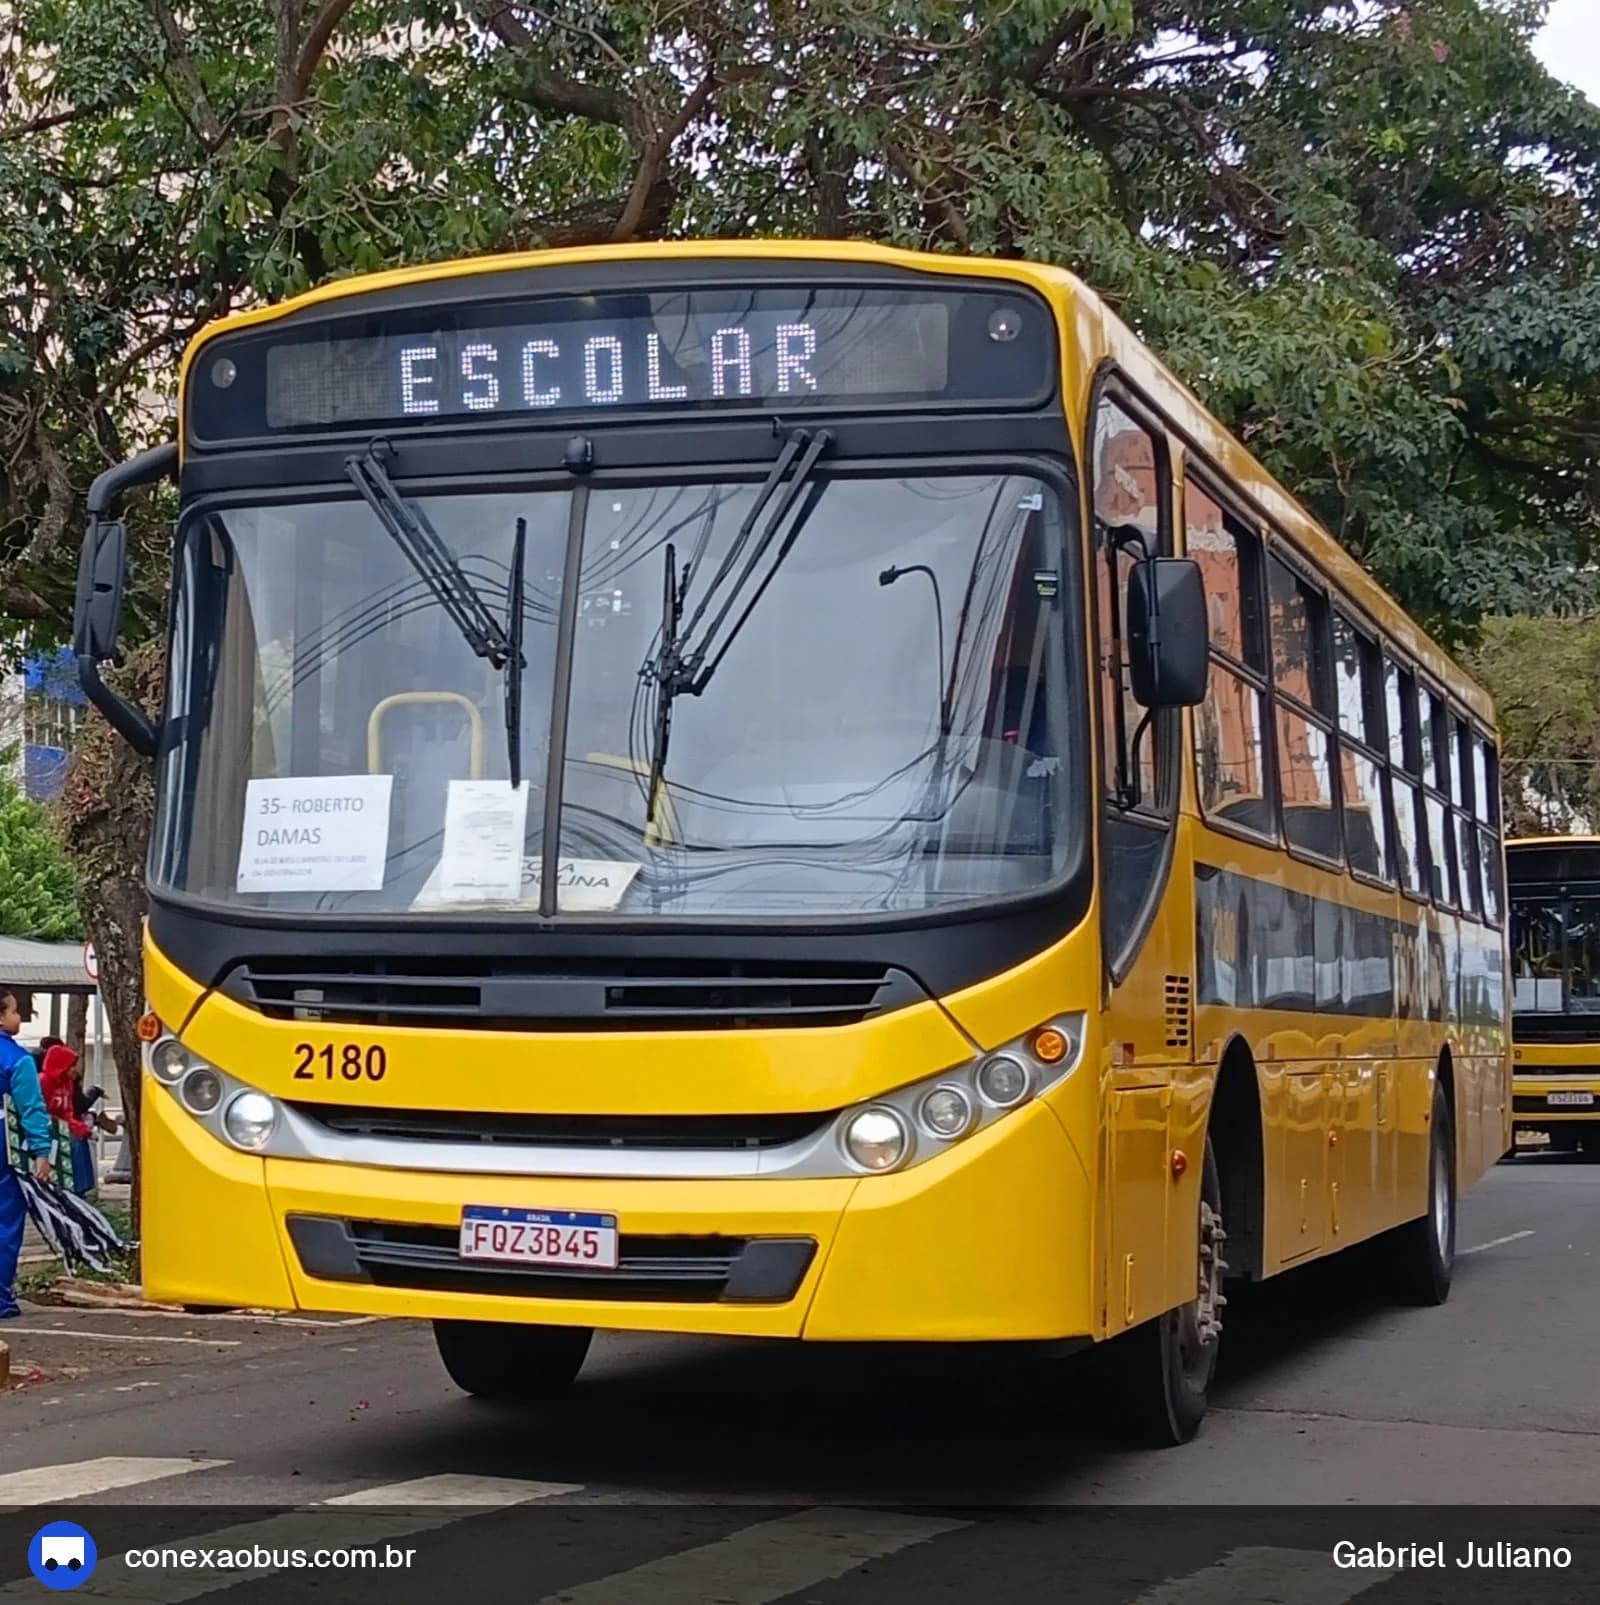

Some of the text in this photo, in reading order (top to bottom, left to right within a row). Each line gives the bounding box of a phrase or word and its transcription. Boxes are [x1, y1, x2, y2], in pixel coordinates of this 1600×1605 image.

[400, 322, 818, 415] ESCOLAR
[259, 797, 365, 816] 35- ROBERTO
[256, 827, 322, 847] DAMAS
[293, 1042, 387, 1082] 2180
[473, 1222, 599, 1259] FQZ3B45
